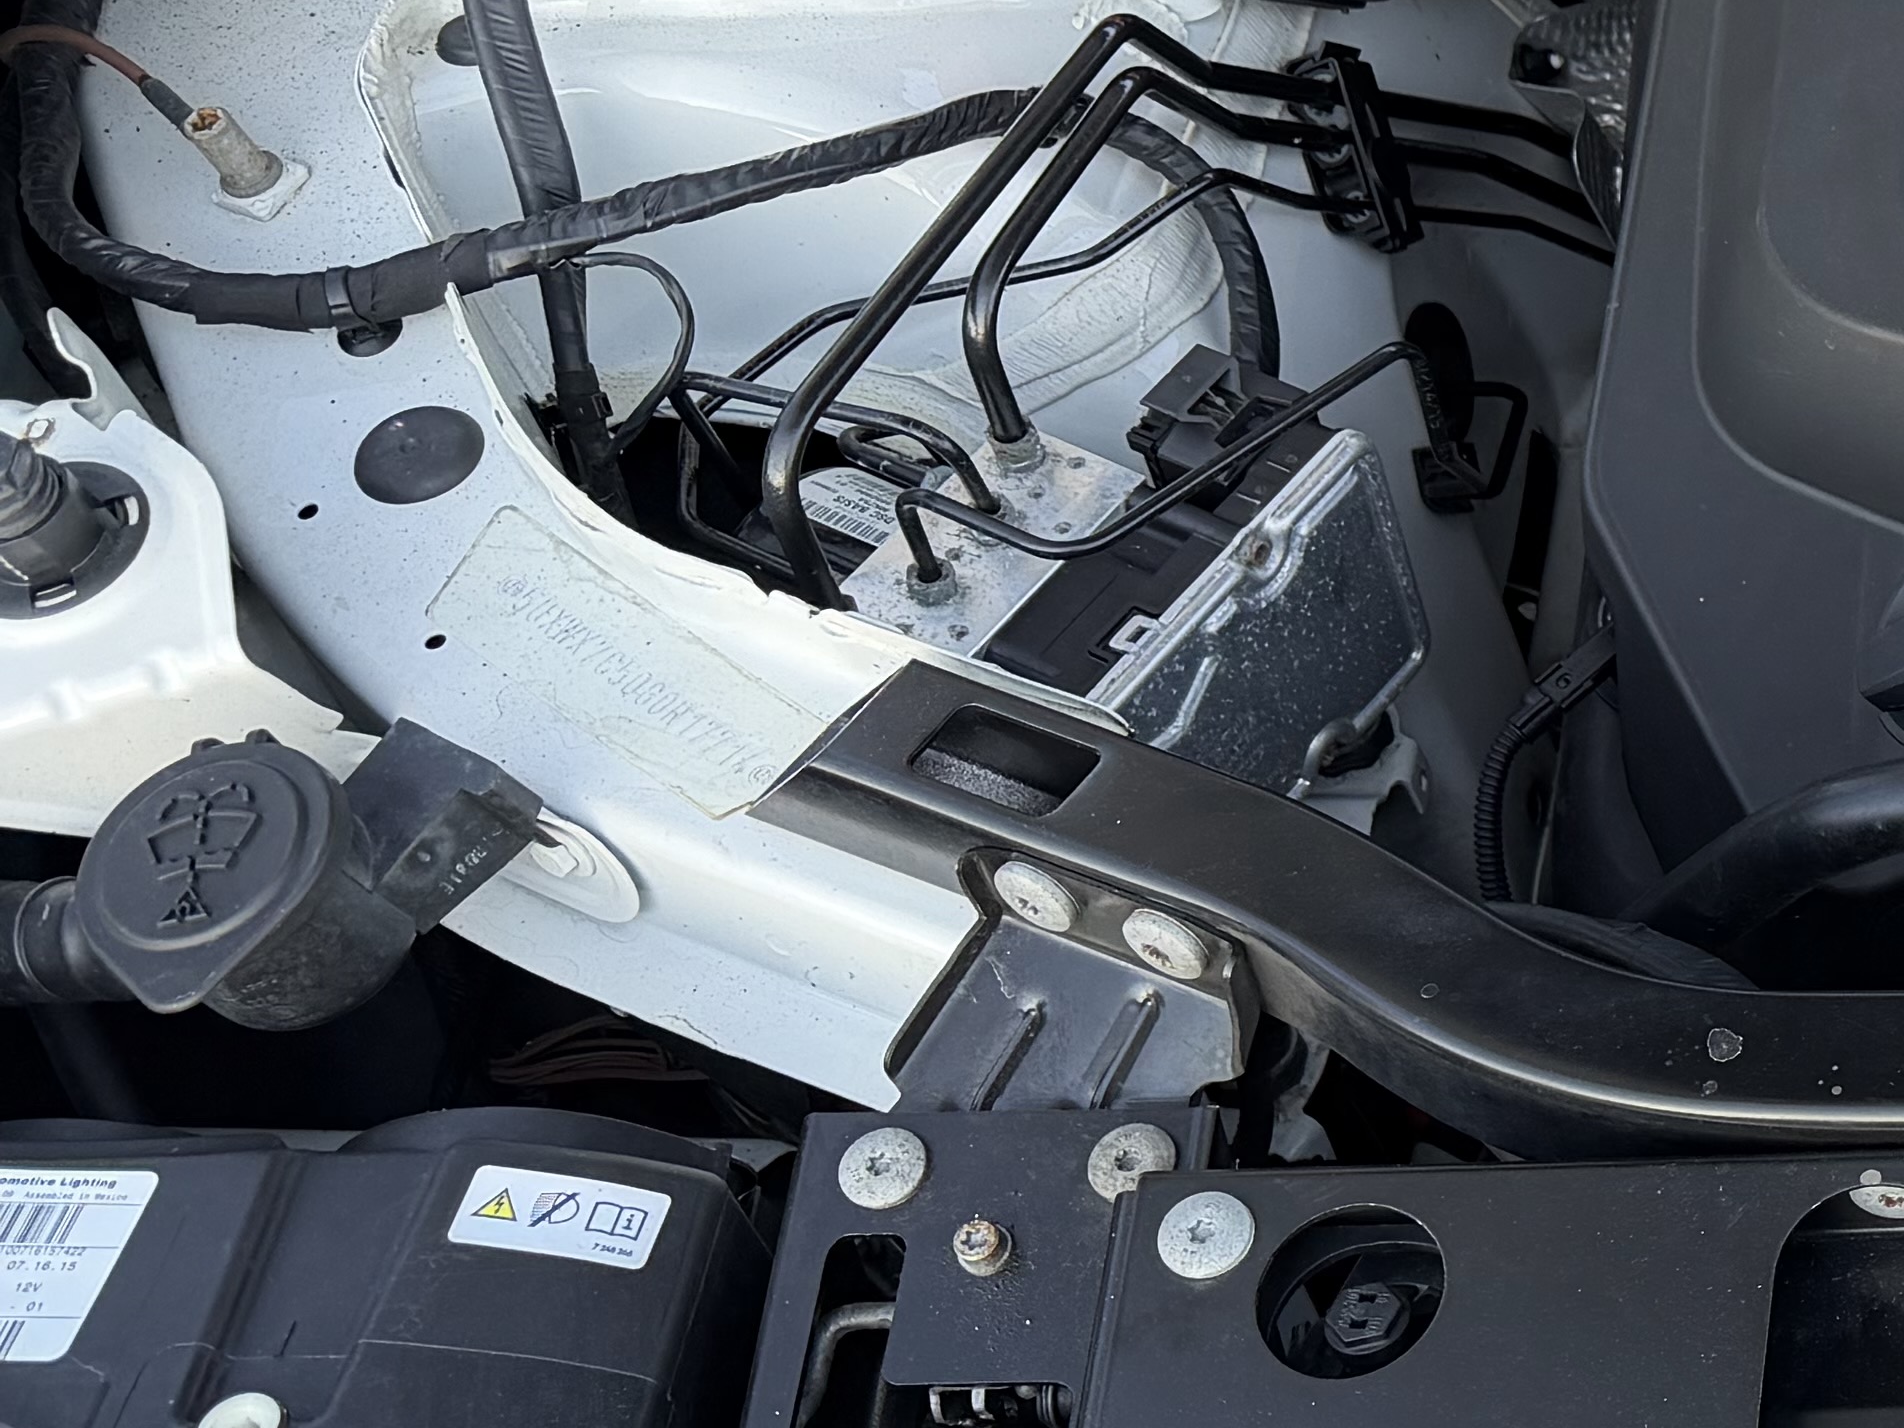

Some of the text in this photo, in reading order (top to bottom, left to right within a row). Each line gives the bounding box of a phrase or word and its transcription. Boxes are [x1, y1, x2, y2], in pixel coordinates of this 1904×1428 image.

[869, 509, 896, 525] DSC
[60, 1178, 118, 1190] Lighting
[24, 1190, 74, 1201] Assembled
[79, 1192, 91, 1201] in
[7, 1260, 77, 1272] 07.16.15
[15, 1281, 43, 1293] 12V
[26, 1301, 44, 1313] 01
